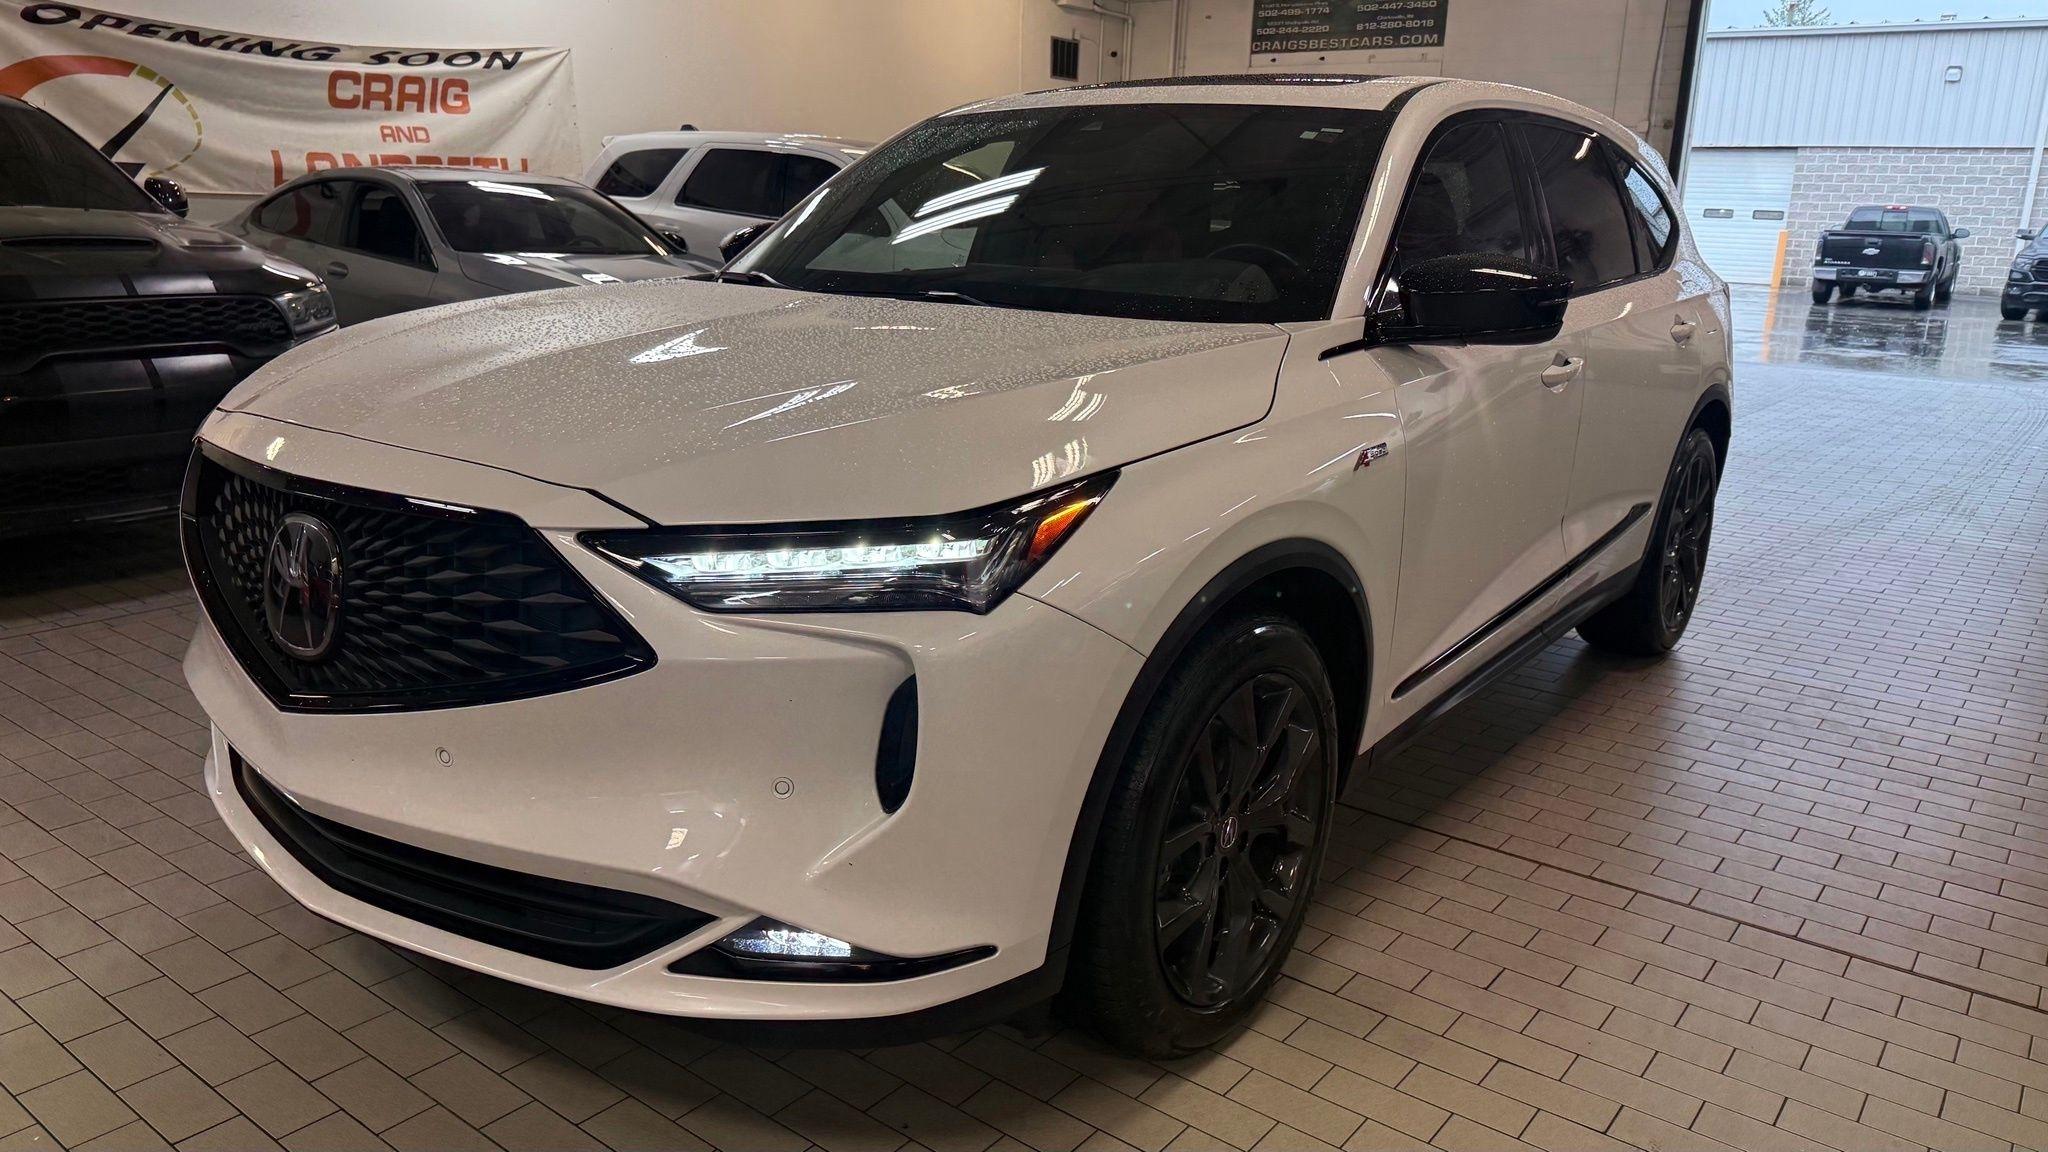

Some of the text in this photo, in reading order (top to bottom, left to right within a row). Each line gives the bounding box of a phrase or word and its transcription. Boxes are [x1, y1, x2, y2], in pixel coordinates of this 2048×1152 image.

[20, 3, 524, 70] OPENING SOON
[1252, 34, 1438, 51] CRAIGSBESTCARS.COM
[328, 70, 471, 115] CRAIG
[380, 125, 431, 143] AND
